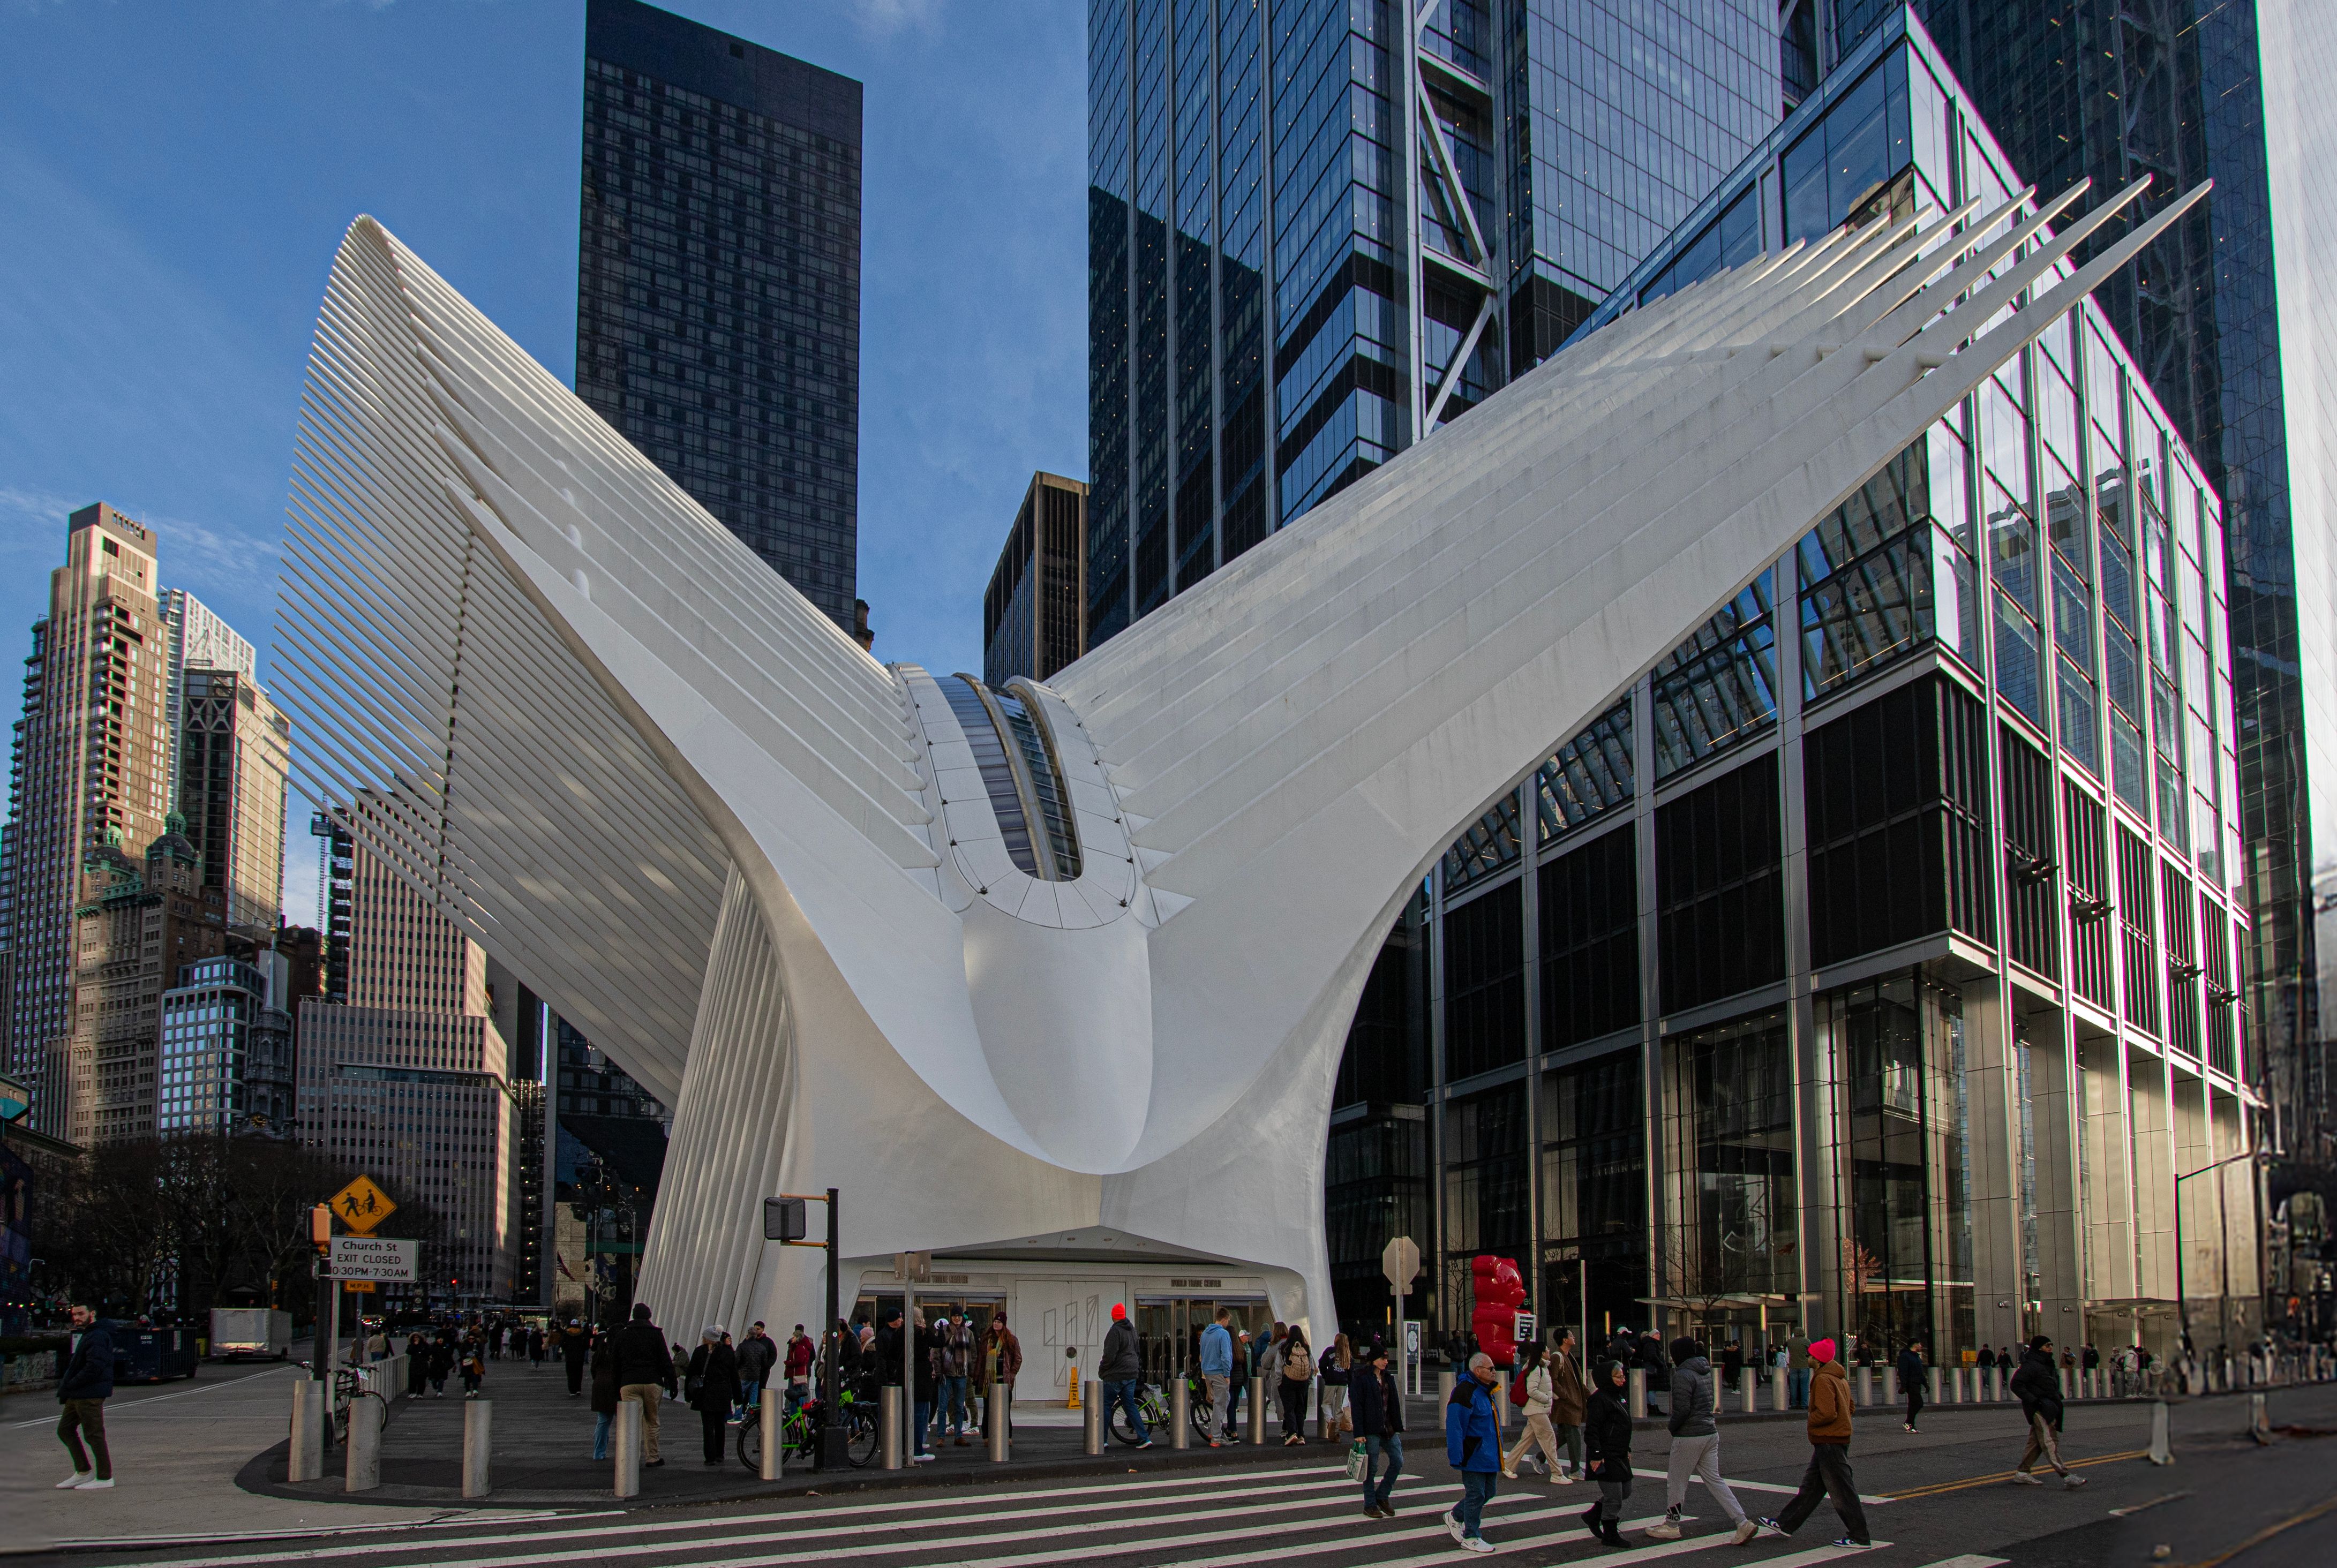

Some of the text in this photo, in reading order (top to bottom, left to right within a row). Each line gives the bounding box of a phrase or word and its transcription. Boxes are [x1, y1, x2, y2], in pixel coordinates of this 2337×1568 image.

[342, 1241, 397, 1252] Church St
[337, 1254, 401, 1264] EXIT CLOSED
[931, 1275, 948, 1283] TRADE
[1188, 1279, 1203, 1287] TRADE
[1204, 1279, 1221, 1287] CENTER
